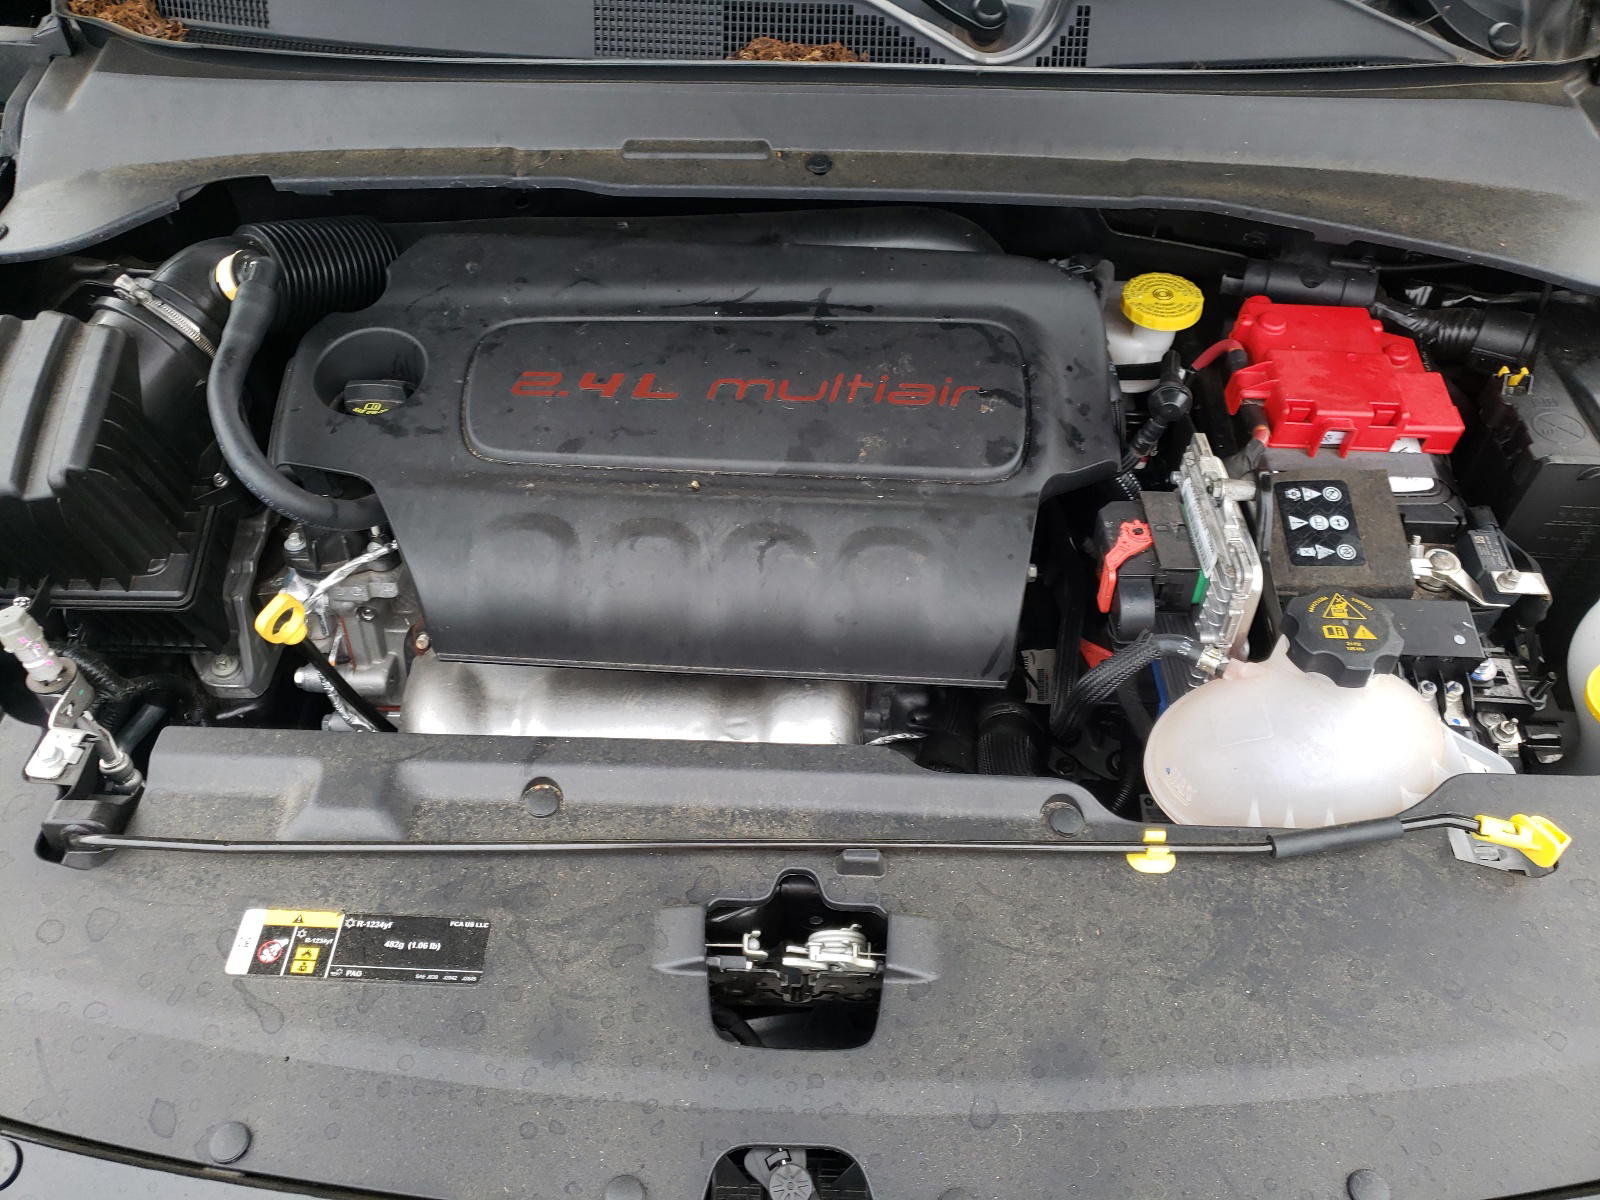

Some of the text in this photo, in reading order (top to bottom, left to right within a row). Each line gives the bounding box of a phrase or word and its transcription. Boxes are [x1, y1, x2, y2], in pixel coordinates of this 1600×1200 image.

[706, 373, 980, 407] multiair
[356, 920, 394, 930] R-1234yf
[449, 920, 464, 928] FCA
[383, 940, 405, 950] 482g
[407, 941, 429, 951] (1.06
[345, 969, 363, 977] PAG
